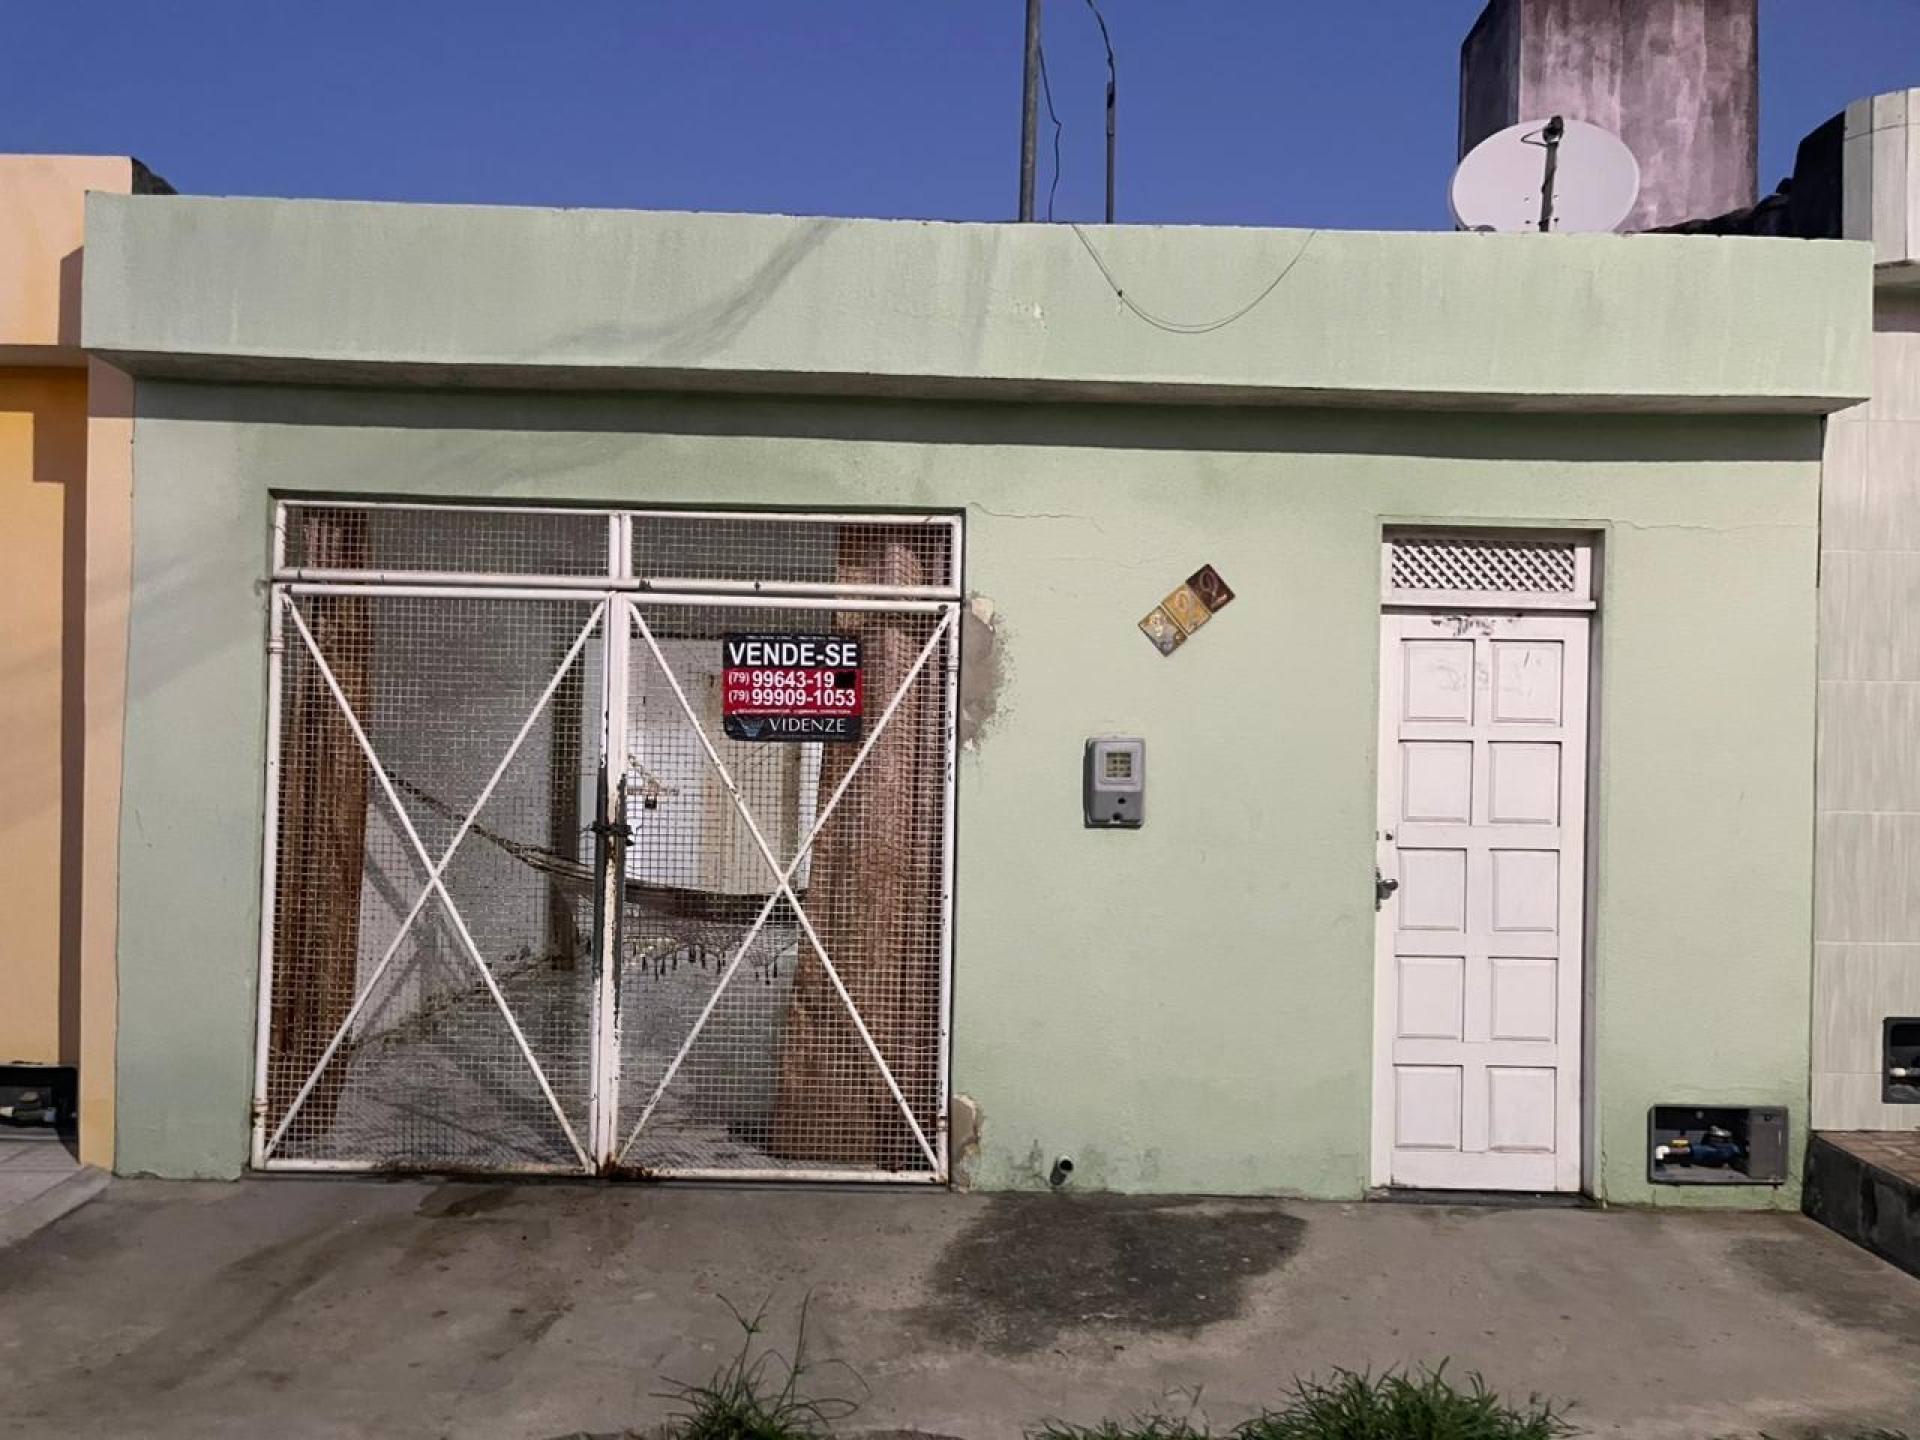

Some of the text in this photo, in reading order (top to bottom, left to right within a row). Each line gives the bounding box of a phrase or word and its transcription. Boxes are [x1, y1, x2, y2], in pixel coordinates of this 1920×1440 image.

[729, 643, 857, 666] VENDE-SE
[728, 671, 855, 688] (79) 99643-19
[728, 689, 856, 706] (79) 99909-1053
[768, 718, 847, 733] VIDENZE
